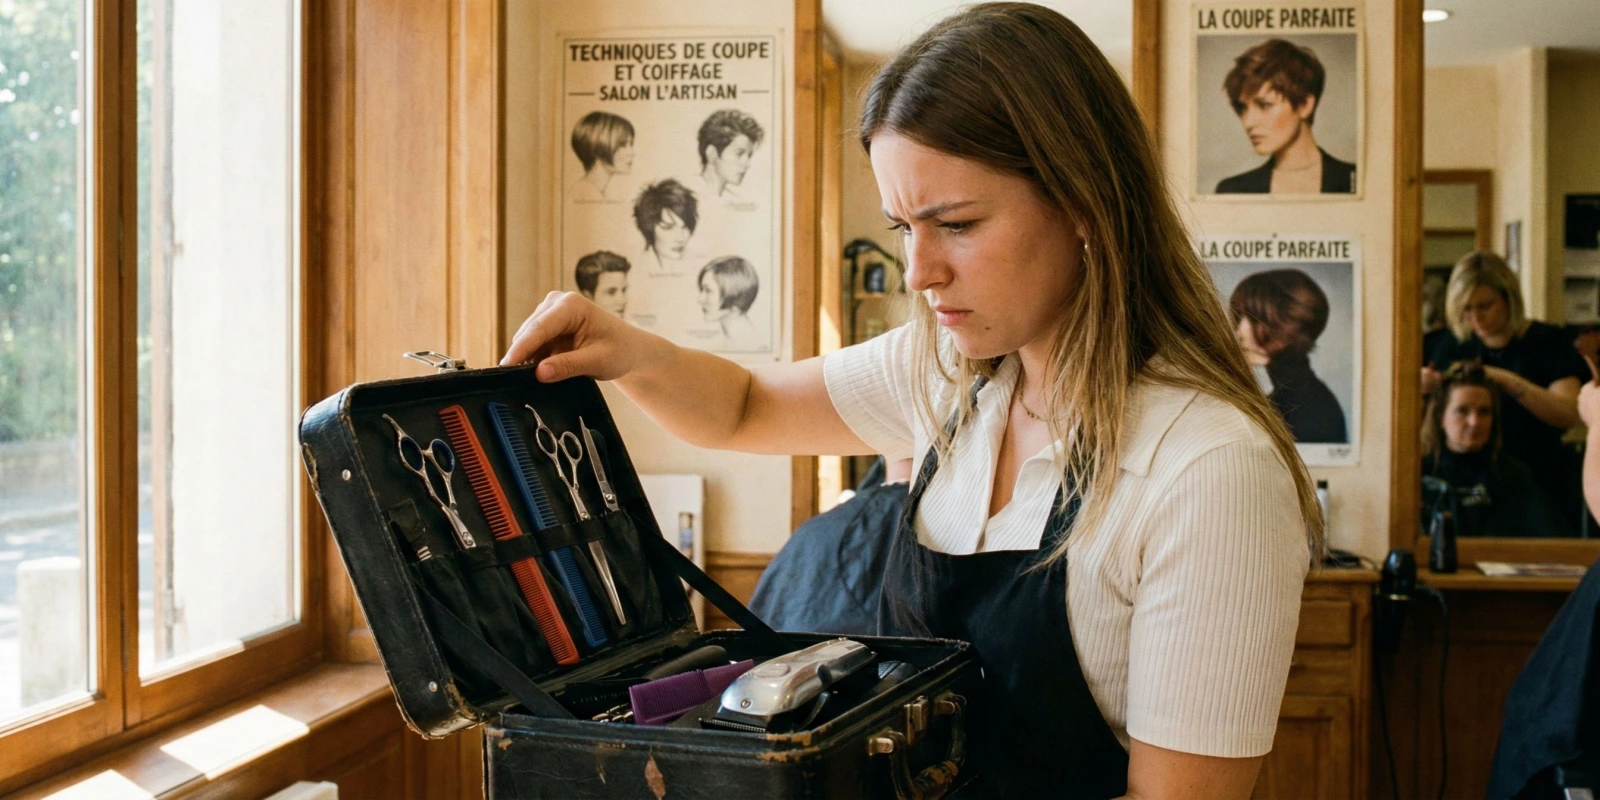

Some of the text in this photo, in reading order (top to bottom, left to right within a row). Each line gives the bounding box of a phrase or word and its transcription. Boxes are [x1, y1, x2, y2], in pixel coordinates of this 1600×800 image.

[1198, 8, 1356, 29] LA COUPE PARFAITE
[570, 42, 769, 62] TECHNIQUES DE COUPE
[614, 63, 722, 81] ET COIFFAGE
[599, 84, 737, 101] SALON L'ARTISAN
[1200, 240, 1350, 258] LA COUPE PARFAITE
